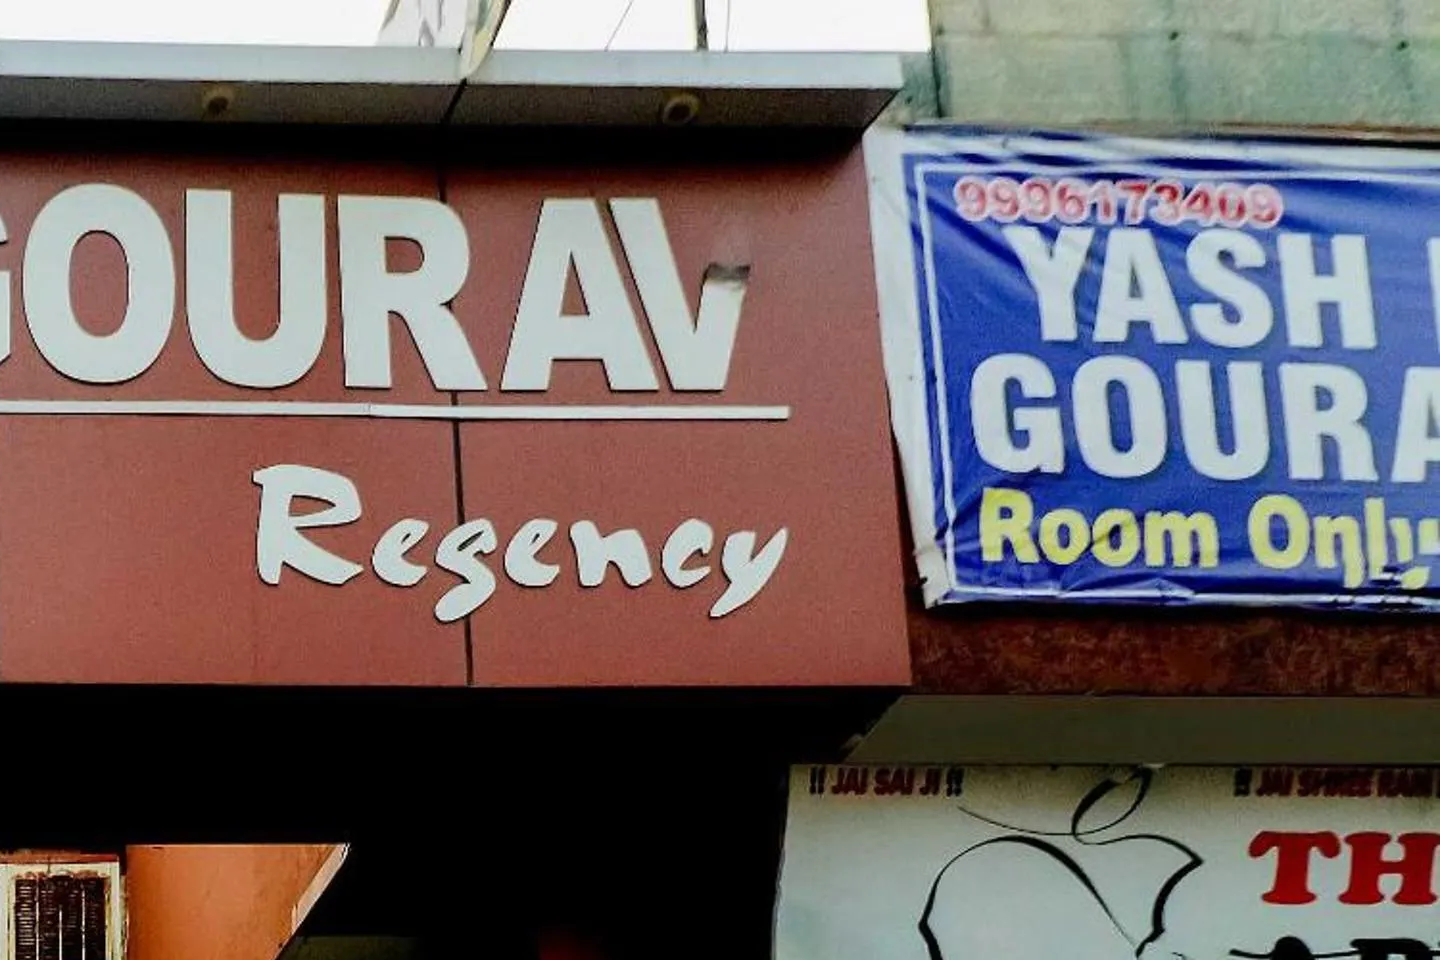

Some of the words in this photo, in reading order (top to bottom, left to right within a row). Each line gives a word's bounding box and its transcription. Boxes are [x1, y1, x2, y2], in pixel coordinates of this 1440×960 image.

[1001, 226, 1377, 350] YASH
[971, 352, 1440, 483] GOURA
[252, 464, 789, 623] Regency
[979, 487, 1220, 568] Room
[832, 767, 868, 796] JAI
[1248, 831, 1440, 905] TH
